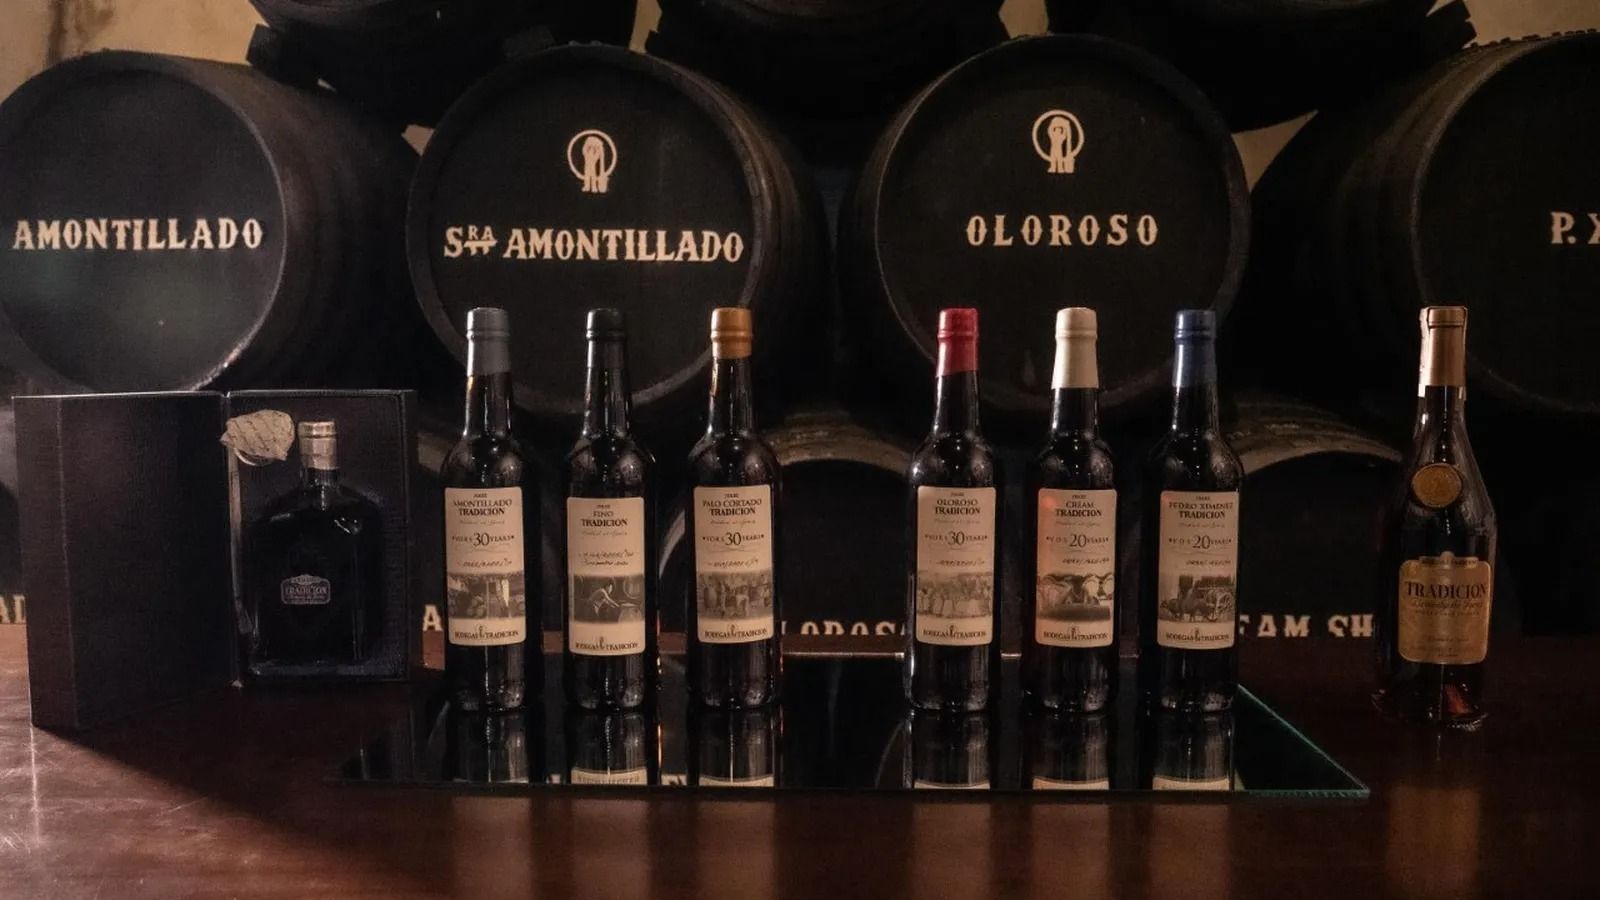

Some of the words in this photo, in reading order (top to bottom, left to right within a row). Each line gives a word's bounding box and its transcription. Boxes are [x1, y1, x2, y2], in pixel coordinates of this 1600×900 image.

[966, 214, 1158, 246] OLOROSO
[1550, 211, 1577, 245] P.
[12, 217, 263, 251] AMONTILLADO
[502, 228, 744, 263] AMONTILLADO
[453, 499, 513, 508] AMONTILLADO
[723, 499, 762, 508] CORTADO
[936, 498, 979, 507] OLOROSO
[1066, 501, 1095, 509] CREAM
[1168, 502, 1197, 510] PEDRO
[458, 507, 505, 517] TRADICION
[593, 511, 614, 519] FINO
[709, 507, 756, 517] TRADICION
[935, 506, 981, 516] TRADICION
[1055, 508, 1103, 518] TRADICION
[1179, 510, 1226, 519] TRADICION
[581, 518, 628, 528] TRADICION
[473, 532, 490, 547] 30
[725, 531, 742, 546] 30
[948, 531, 965, 546] 30
[1070, 533, 1087, 548] 20
[1192, 535, 1211, 549] 20
[1404, 580, 1487, 600] TRADICION
